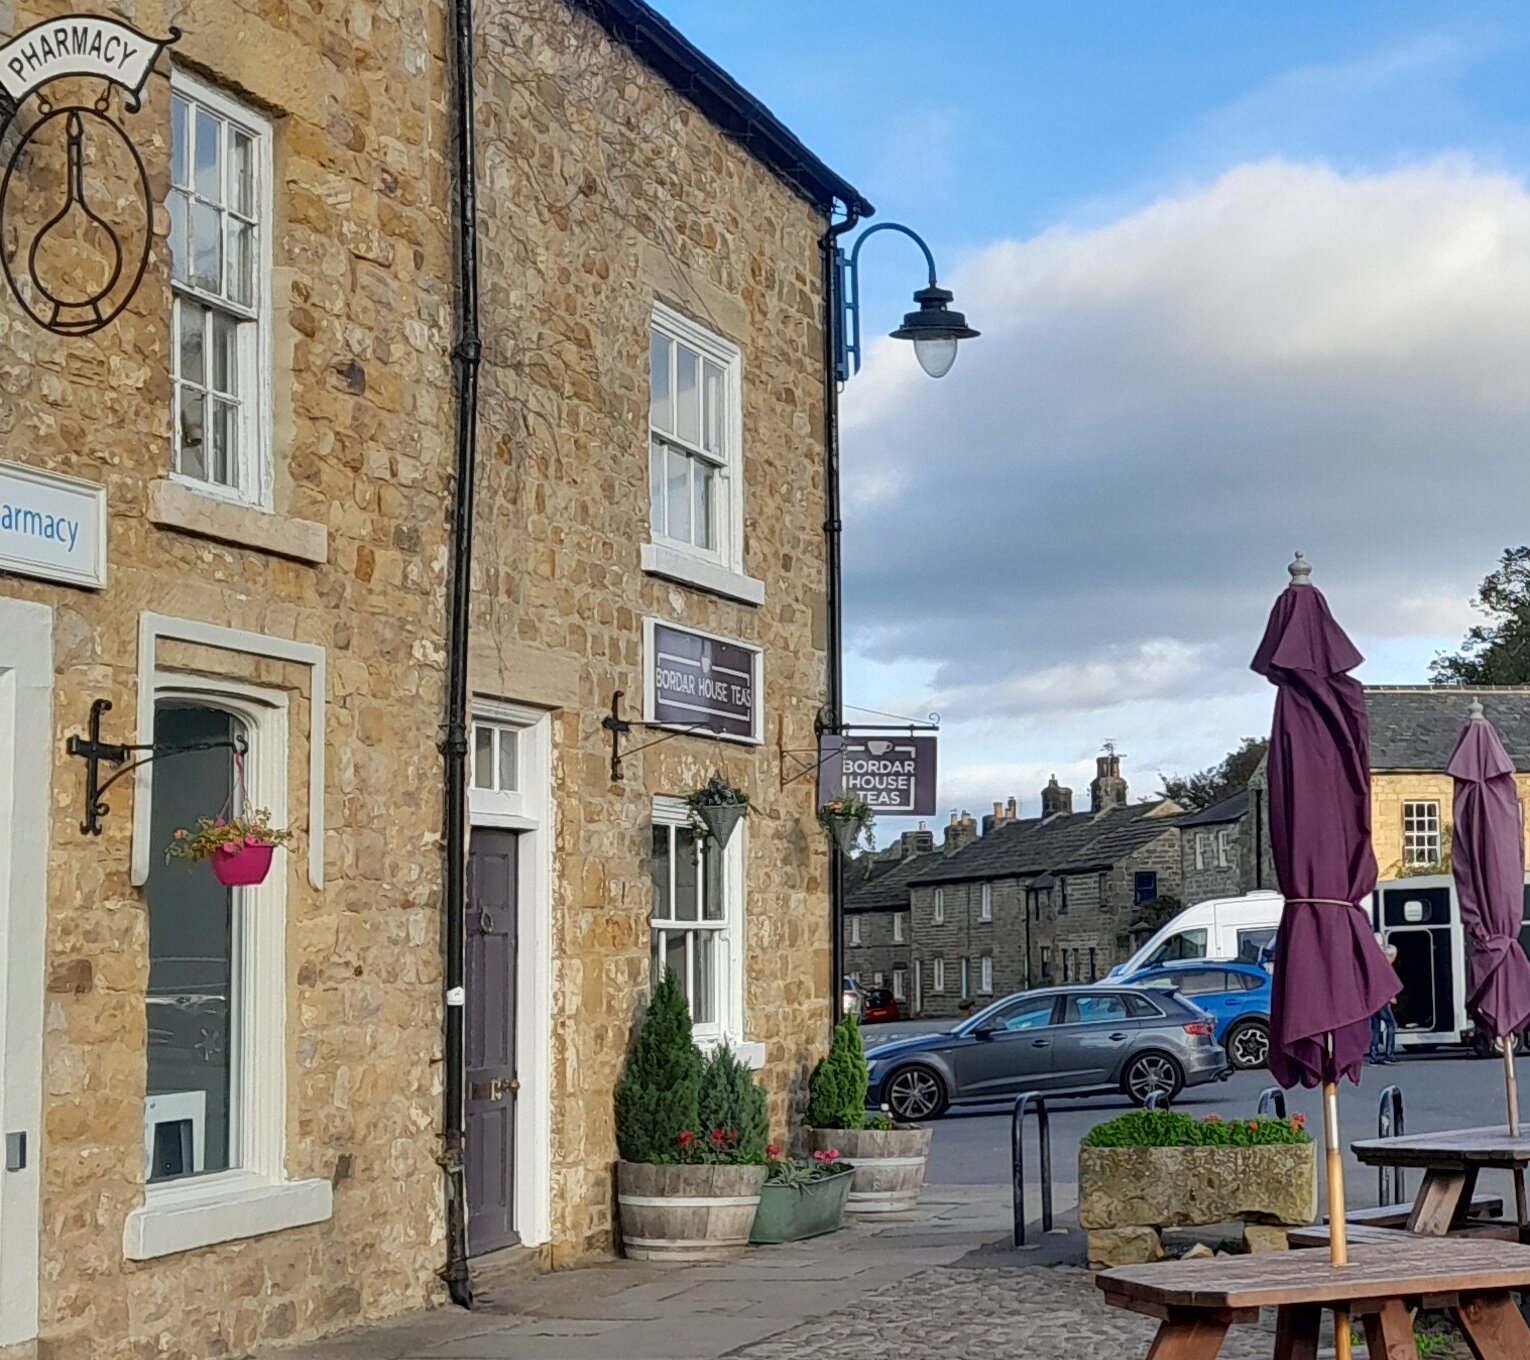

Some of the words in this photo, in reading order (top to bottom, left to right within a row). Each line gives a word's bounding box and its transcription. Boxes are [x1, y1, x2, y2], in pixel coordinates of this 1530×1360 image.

[7, 26, 138, 83] PHARMACY
[1, 504, 79, 553] armacy
[655, 667, 695, 695] BORDAR
[698, 678, 728, 702] HOUSE
[731, 685, 751, 707] TEAS
[842, 760, 915, 774] BORDAR
[848, 775, 908, 790] HOUSE
[856, 791, 901, 805] TEAS
